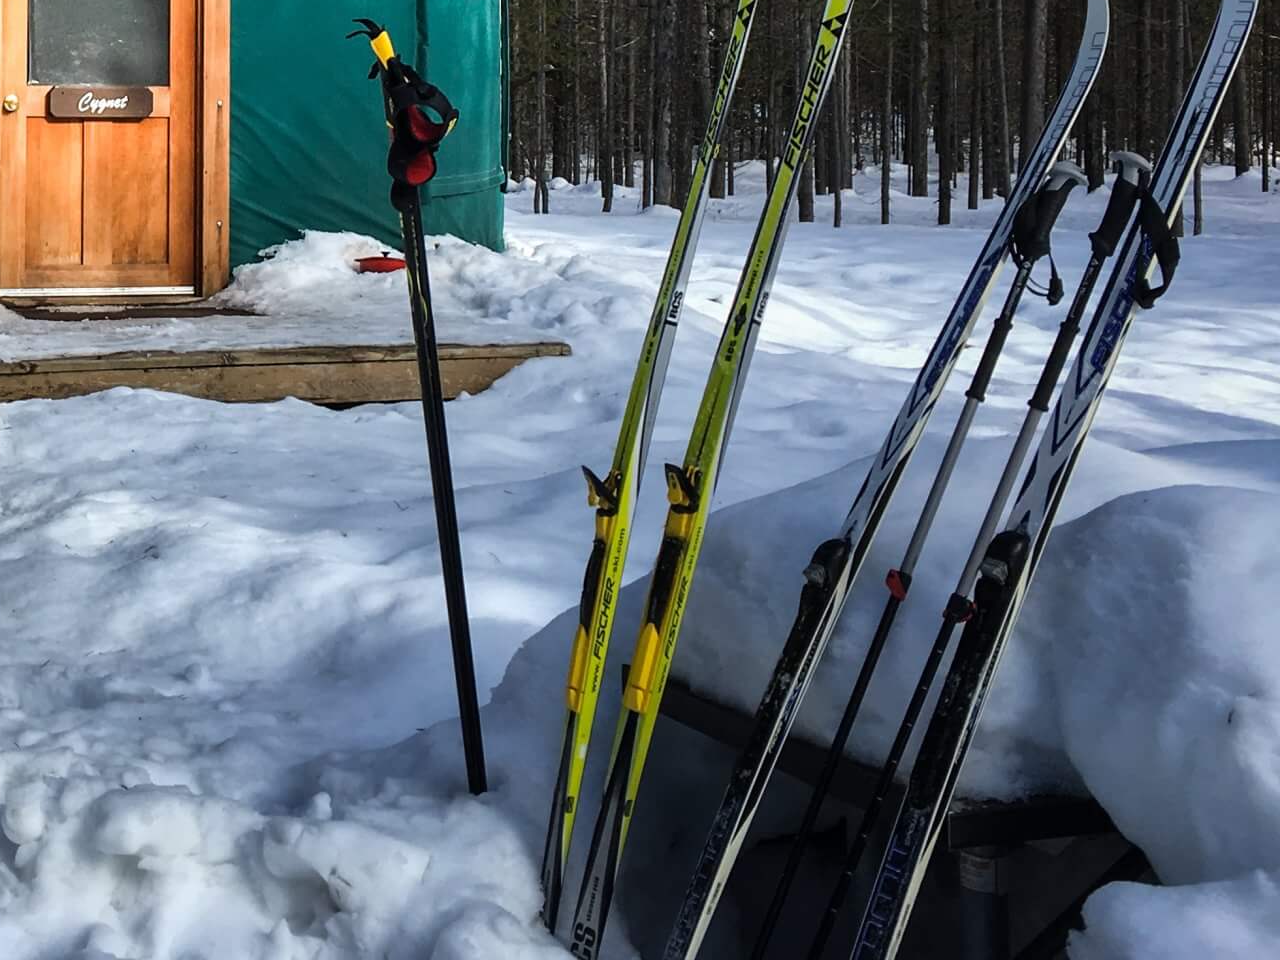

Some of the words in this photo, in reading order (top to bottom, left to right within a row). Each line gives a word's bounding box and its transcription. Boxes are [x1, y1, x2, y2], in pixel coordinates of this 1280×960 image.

[78, 92, 129, 114] Cygnet
[698, 34, 740, 166] FISCHER
[783, 43, 831, 171] FISCHER
